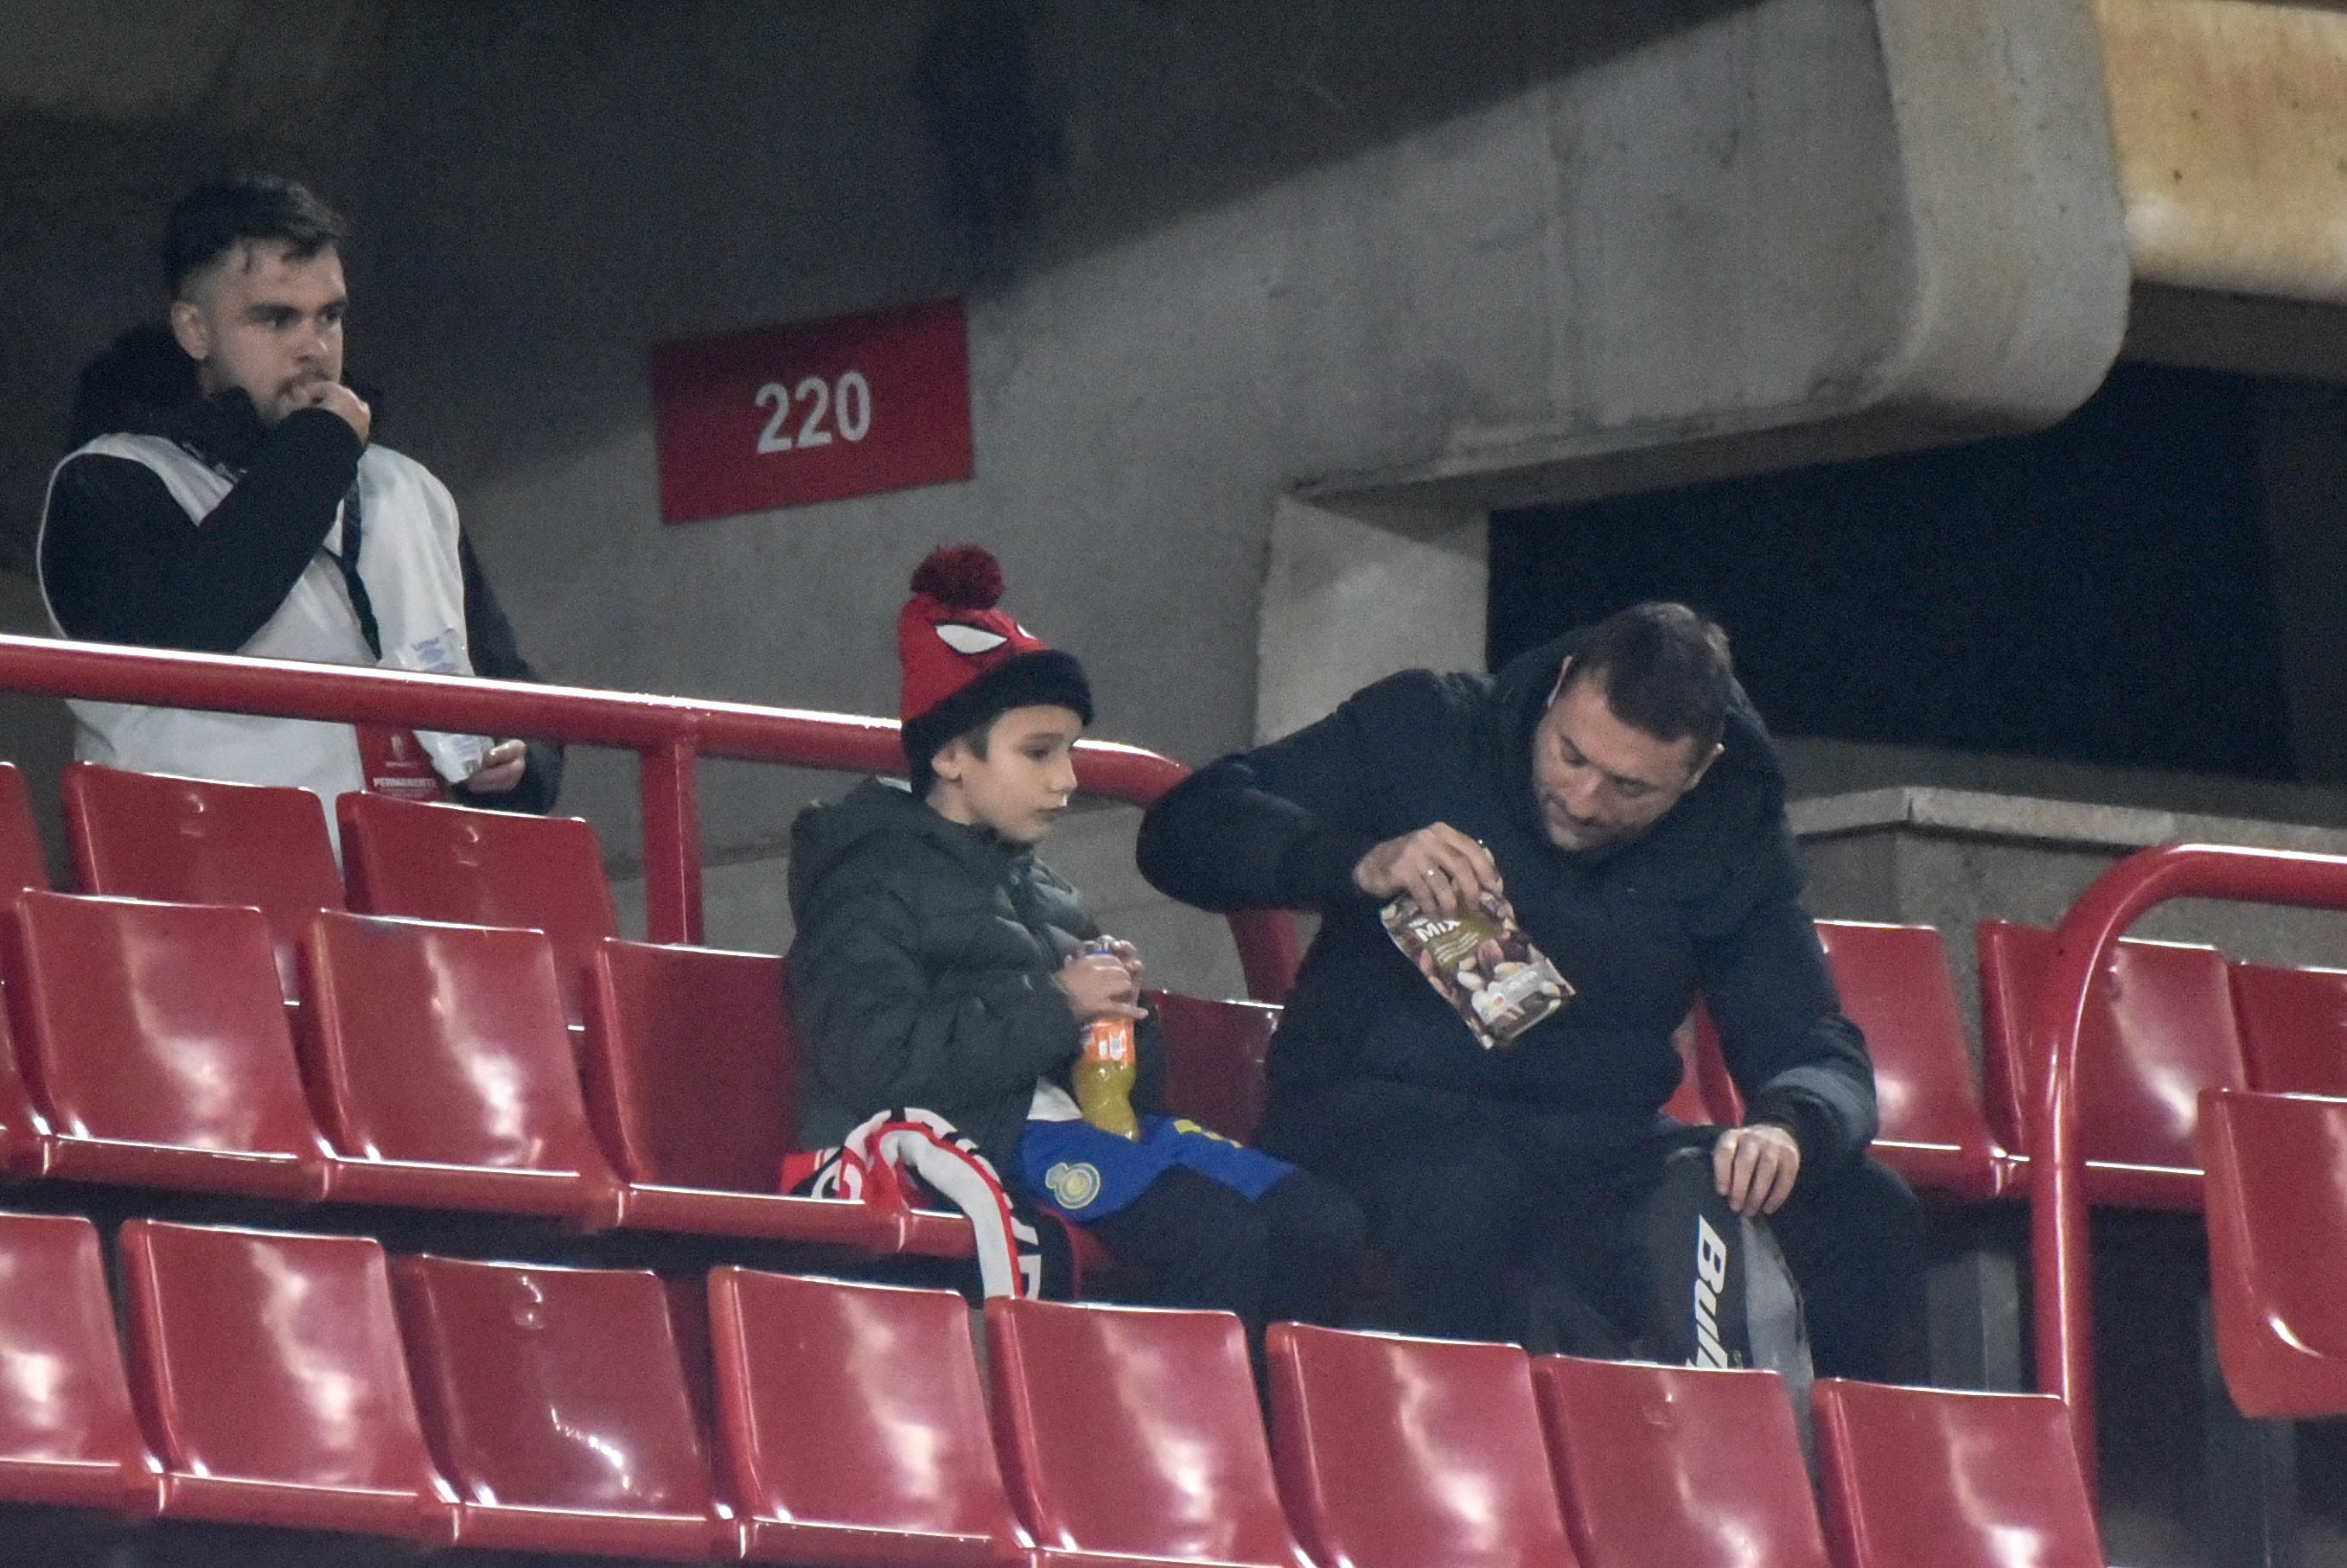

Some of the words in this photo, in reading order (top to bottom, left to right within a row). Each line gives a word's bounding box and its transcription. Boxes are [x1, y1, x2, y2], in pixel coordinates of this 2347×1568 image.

[755, 370, 871, 455] 220
[1414, 919, 1462, 942] MIX
[1687, 1214, 1728, 1369] Bul
